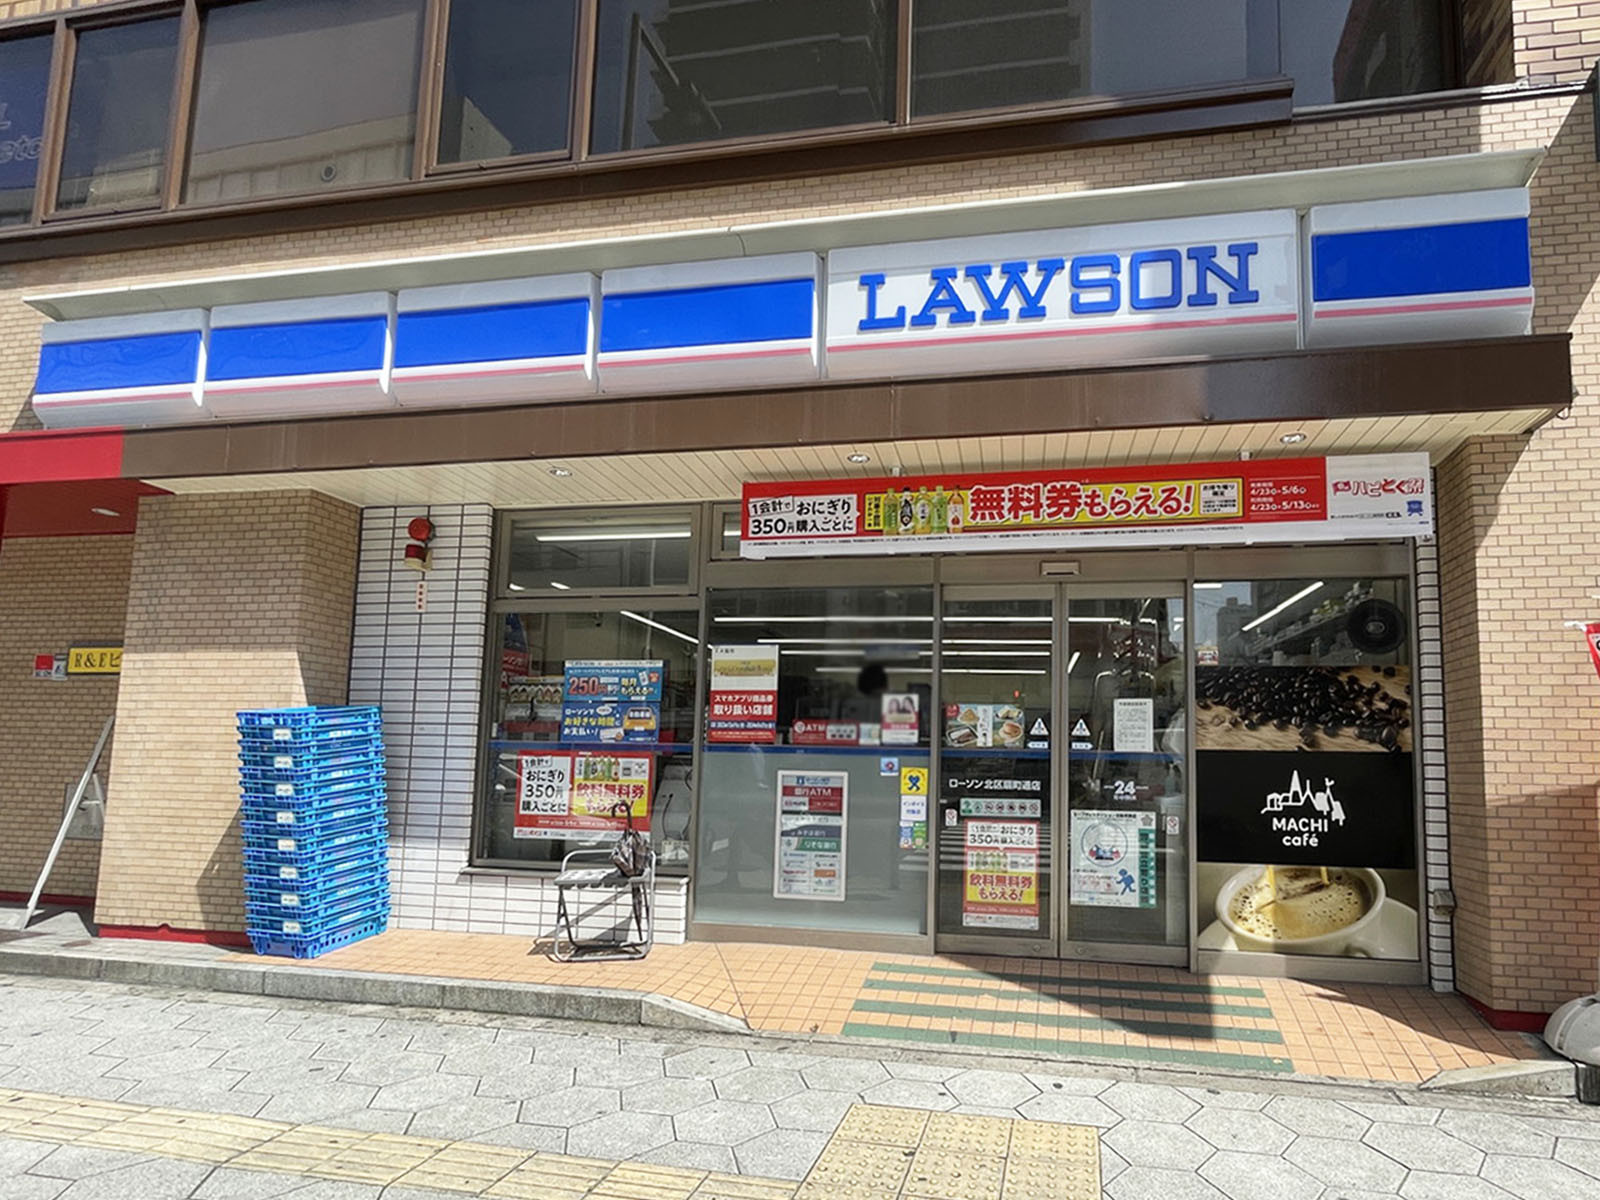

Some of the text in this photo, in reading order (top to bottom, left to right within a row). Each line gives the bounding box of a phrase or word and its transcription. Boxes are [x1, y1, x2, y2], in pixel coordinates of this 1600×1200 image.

[859, 242, 1259, 331] LAWSON
[797, 499, 851, 515] おにぎり
[970, 484, 1193, 521] 無料券もらえる!
[526, 769, 565, 783] おにぎり
[1114, 780, 1136, 795] 24
[522, 800, 567, 813] 購入ごとに
[1272, 817, 1328, 832] MACHI
[1282, 833, 1319, 847] café
[979, 887, 1024, 901] もらえる!
